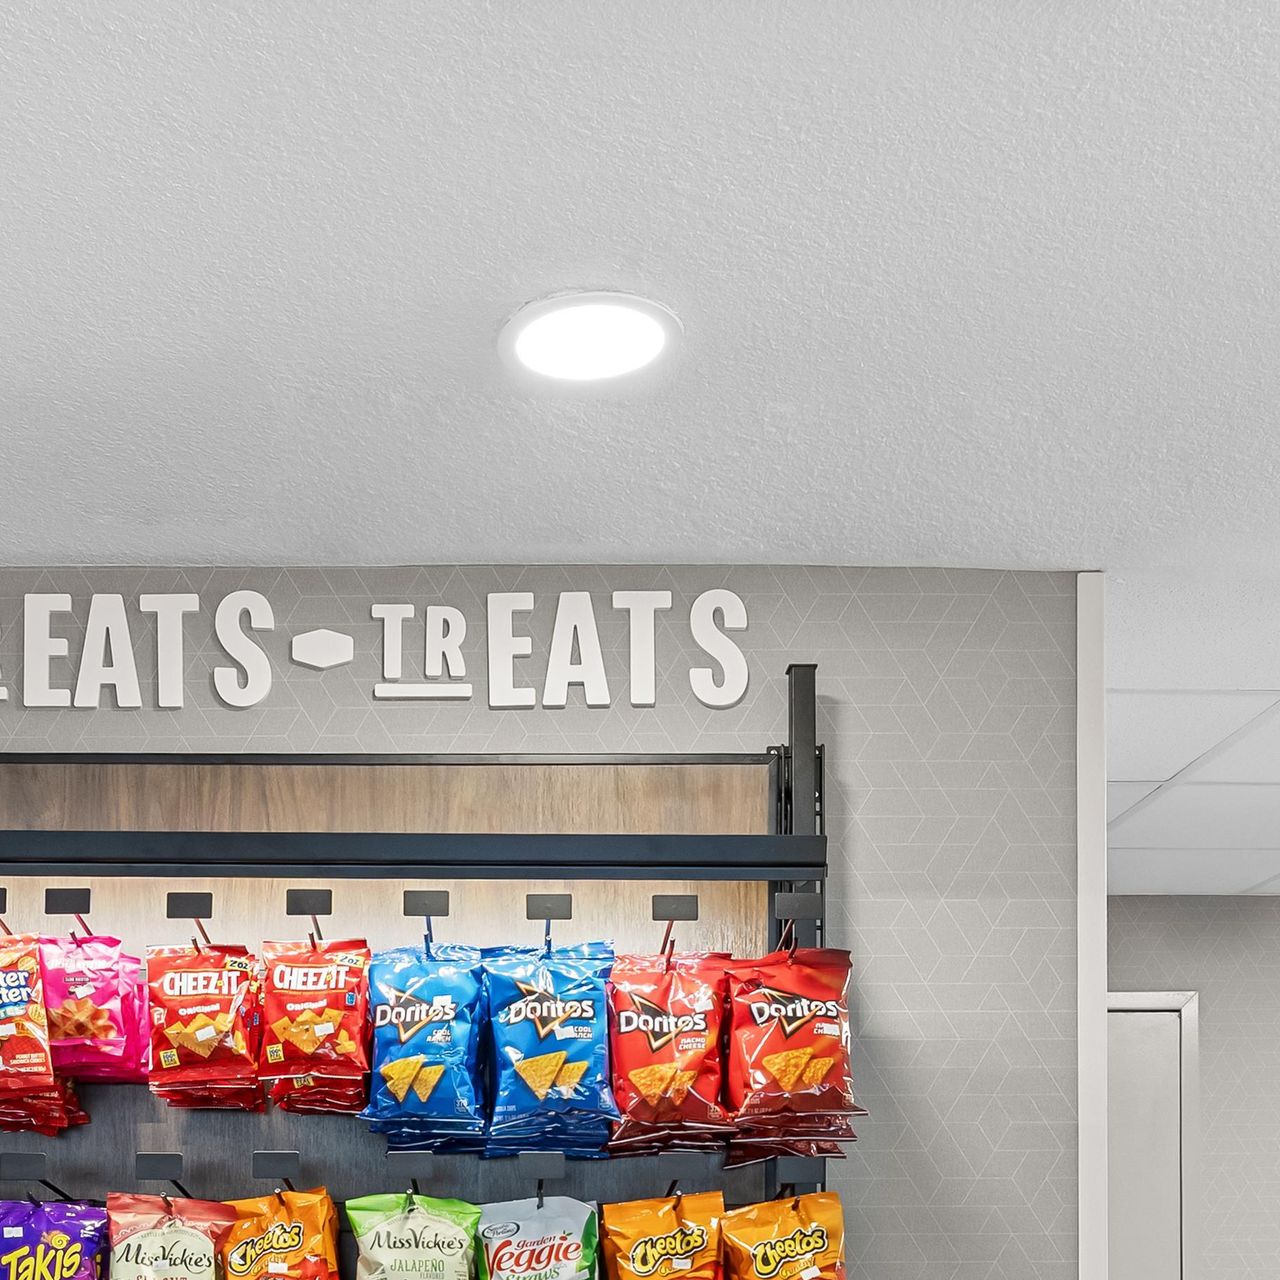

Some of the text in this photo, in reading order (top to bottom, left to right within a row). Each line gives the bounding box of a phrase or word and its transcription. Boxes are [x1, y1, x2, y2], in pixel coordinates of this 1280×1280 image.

[376, 1001, 456, 1027] Doritos
[509, 1000, 594, 1025] Doritos
[619, 1010, 706, 1034] Doritos
[750, 1000, 838, 1026] Doritos
[228, 1222, 303, 1277] Cheetos
[370, 1225, 466, 1256] Miss Vickie's
[632, 1226, 707, 1274] Cheetos
[754, 1229, 826, 1276] Cheetos
[390, 1258, 445, 1272] JALAPEÑO
[484, 1238, 582, 1280] Veggie
